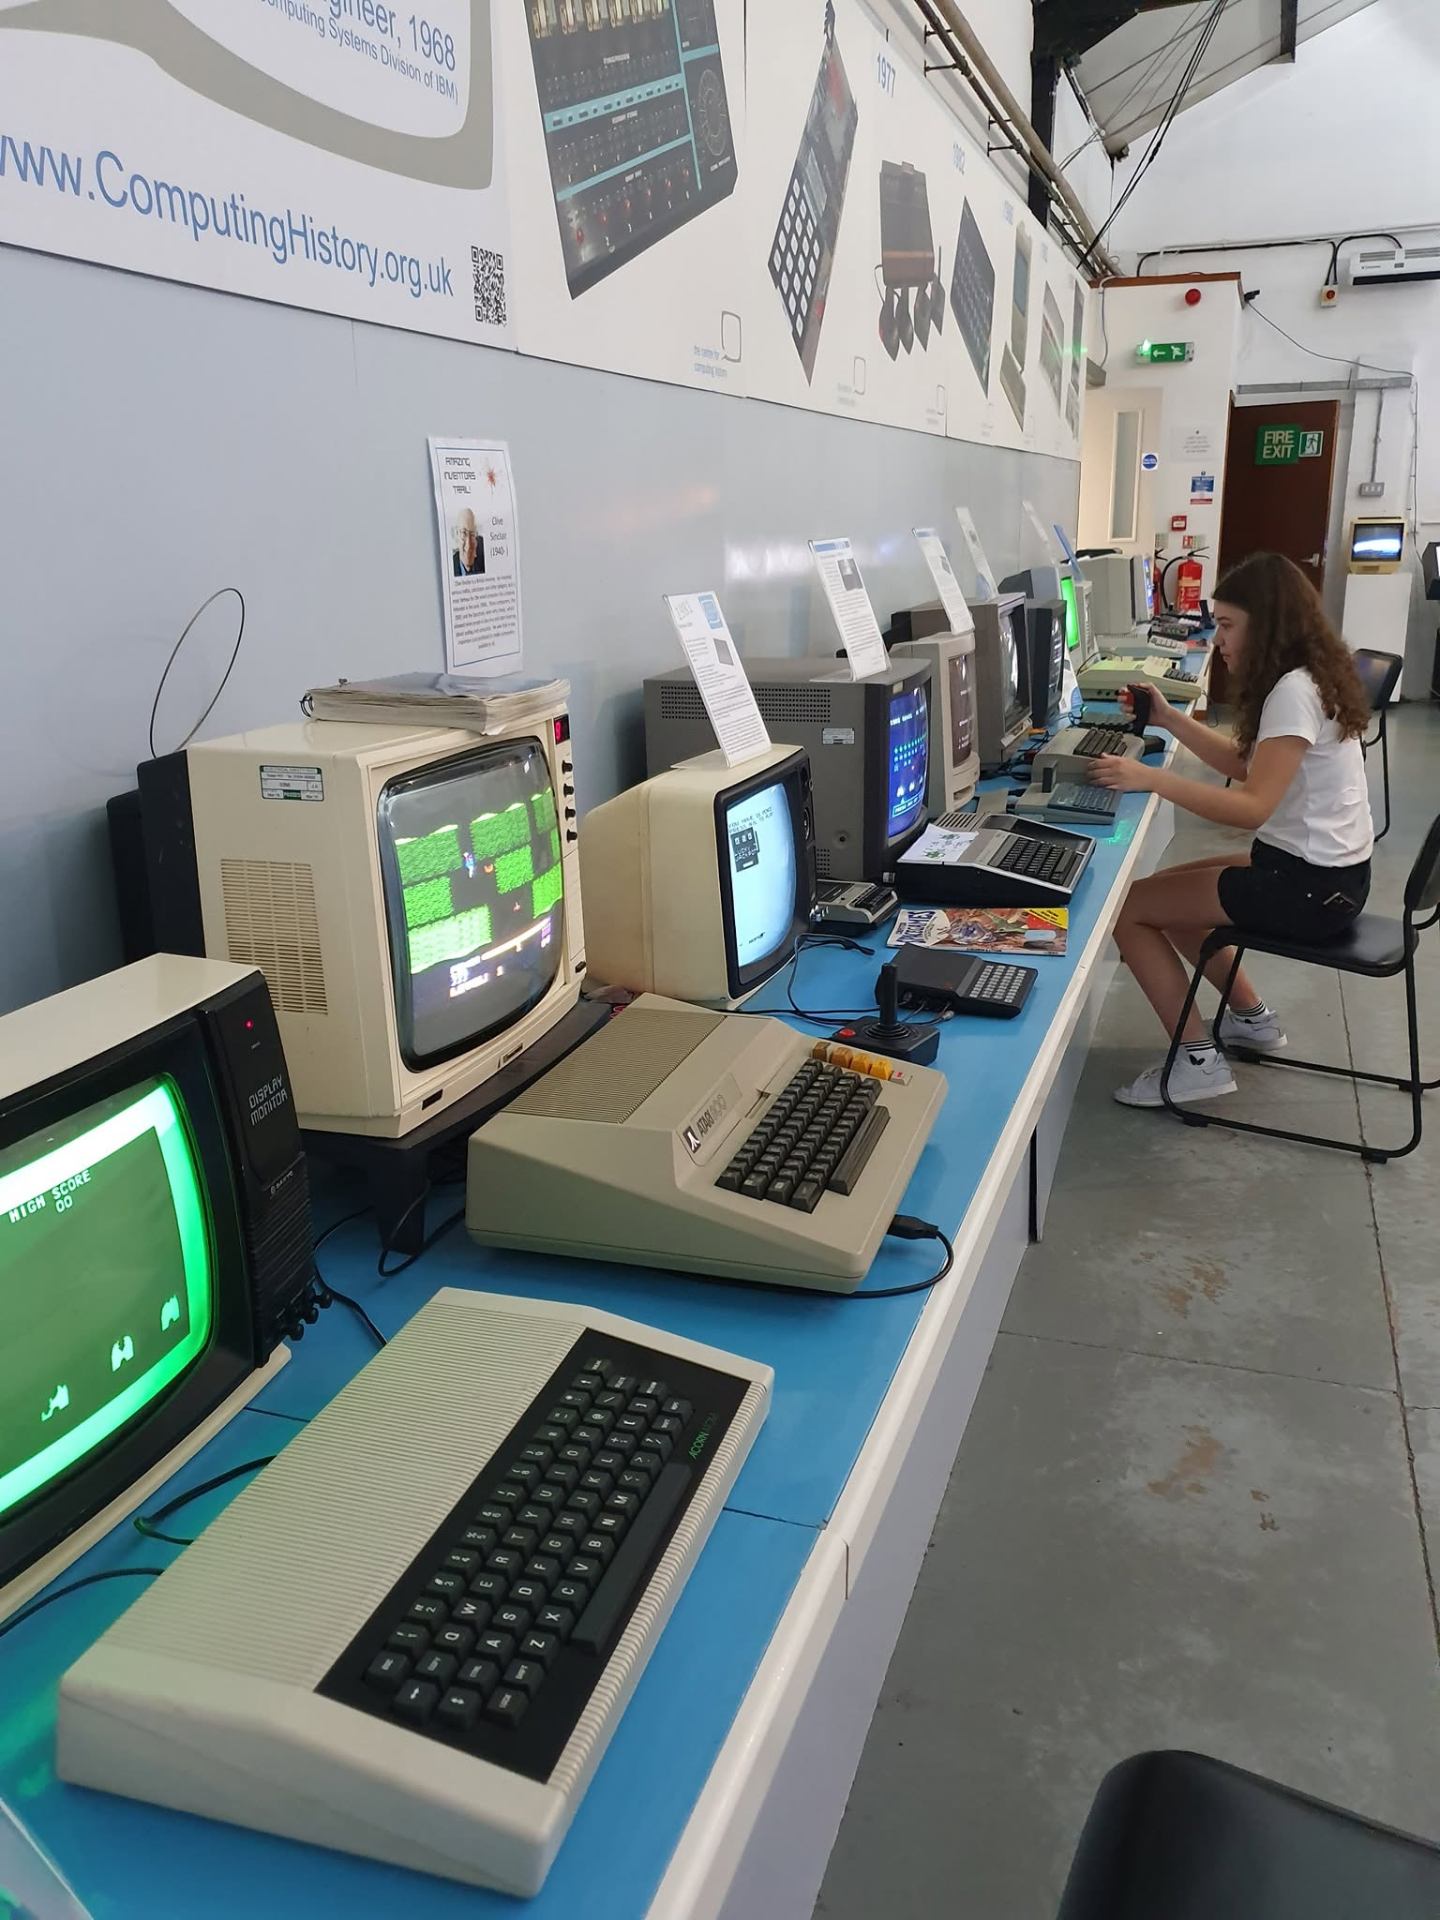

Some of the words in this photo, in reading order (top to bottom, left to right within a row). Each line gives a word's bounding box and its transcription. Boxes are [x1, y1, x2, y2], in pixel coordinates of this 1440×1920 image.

[329, 17, 378, 60] Systems
[381, 44, 421, 83] Division
[424, 70, 433, 89] of
[436, 73, 458, 105] IBM)
[409, 14, 455, 72] 1968
[877, 52, 896, 98] 1977
[0, 134, 454, 297] ww.ComputingHistory.org.uk
[1262, 444, 1295, 459] EXIT
[1264, 430, 1295, 445] FIRE
[248, 1073, 283, 1109] DISPLAY
[250, 1088, 288, 1126] MONITOR
[8, 1194, 46, 1224] HIGH
[51, 1169, 91, 1200] SCORE
[444, 1631, 460, 1641] Q
[461, 1602, 477, 1616] W
[479, 1580, 493, 1589] E
[495, 1555, 510, 1564] R
[511, 1532, 525, 1540] T
[524, 1510, 539, 1520] Y
[486, 1638, 502, 1649] A
[502, 1612, 517, 1622] S
[518, 1586, 533, 1596] D
[534, 1562, 547, 1571] F
[548, 1539, 562, 1549] G
[561, 1517, 576, 1526] H
[576, 1496, 589, 1504] J
[588, 1475, 601, 1484] K
[530, 1639, 545, 1649] Z
[545, 1611, 561, 1622] X
[561, 1587, 576, 1596] C
[574, 1562, 589, 1572] V
[588, 1540, 602, 1548] B
[601, 1517, 616, 1526] N
[614, 1494, 630, 1504] M
[425, 1606, 436, 1614] 2
